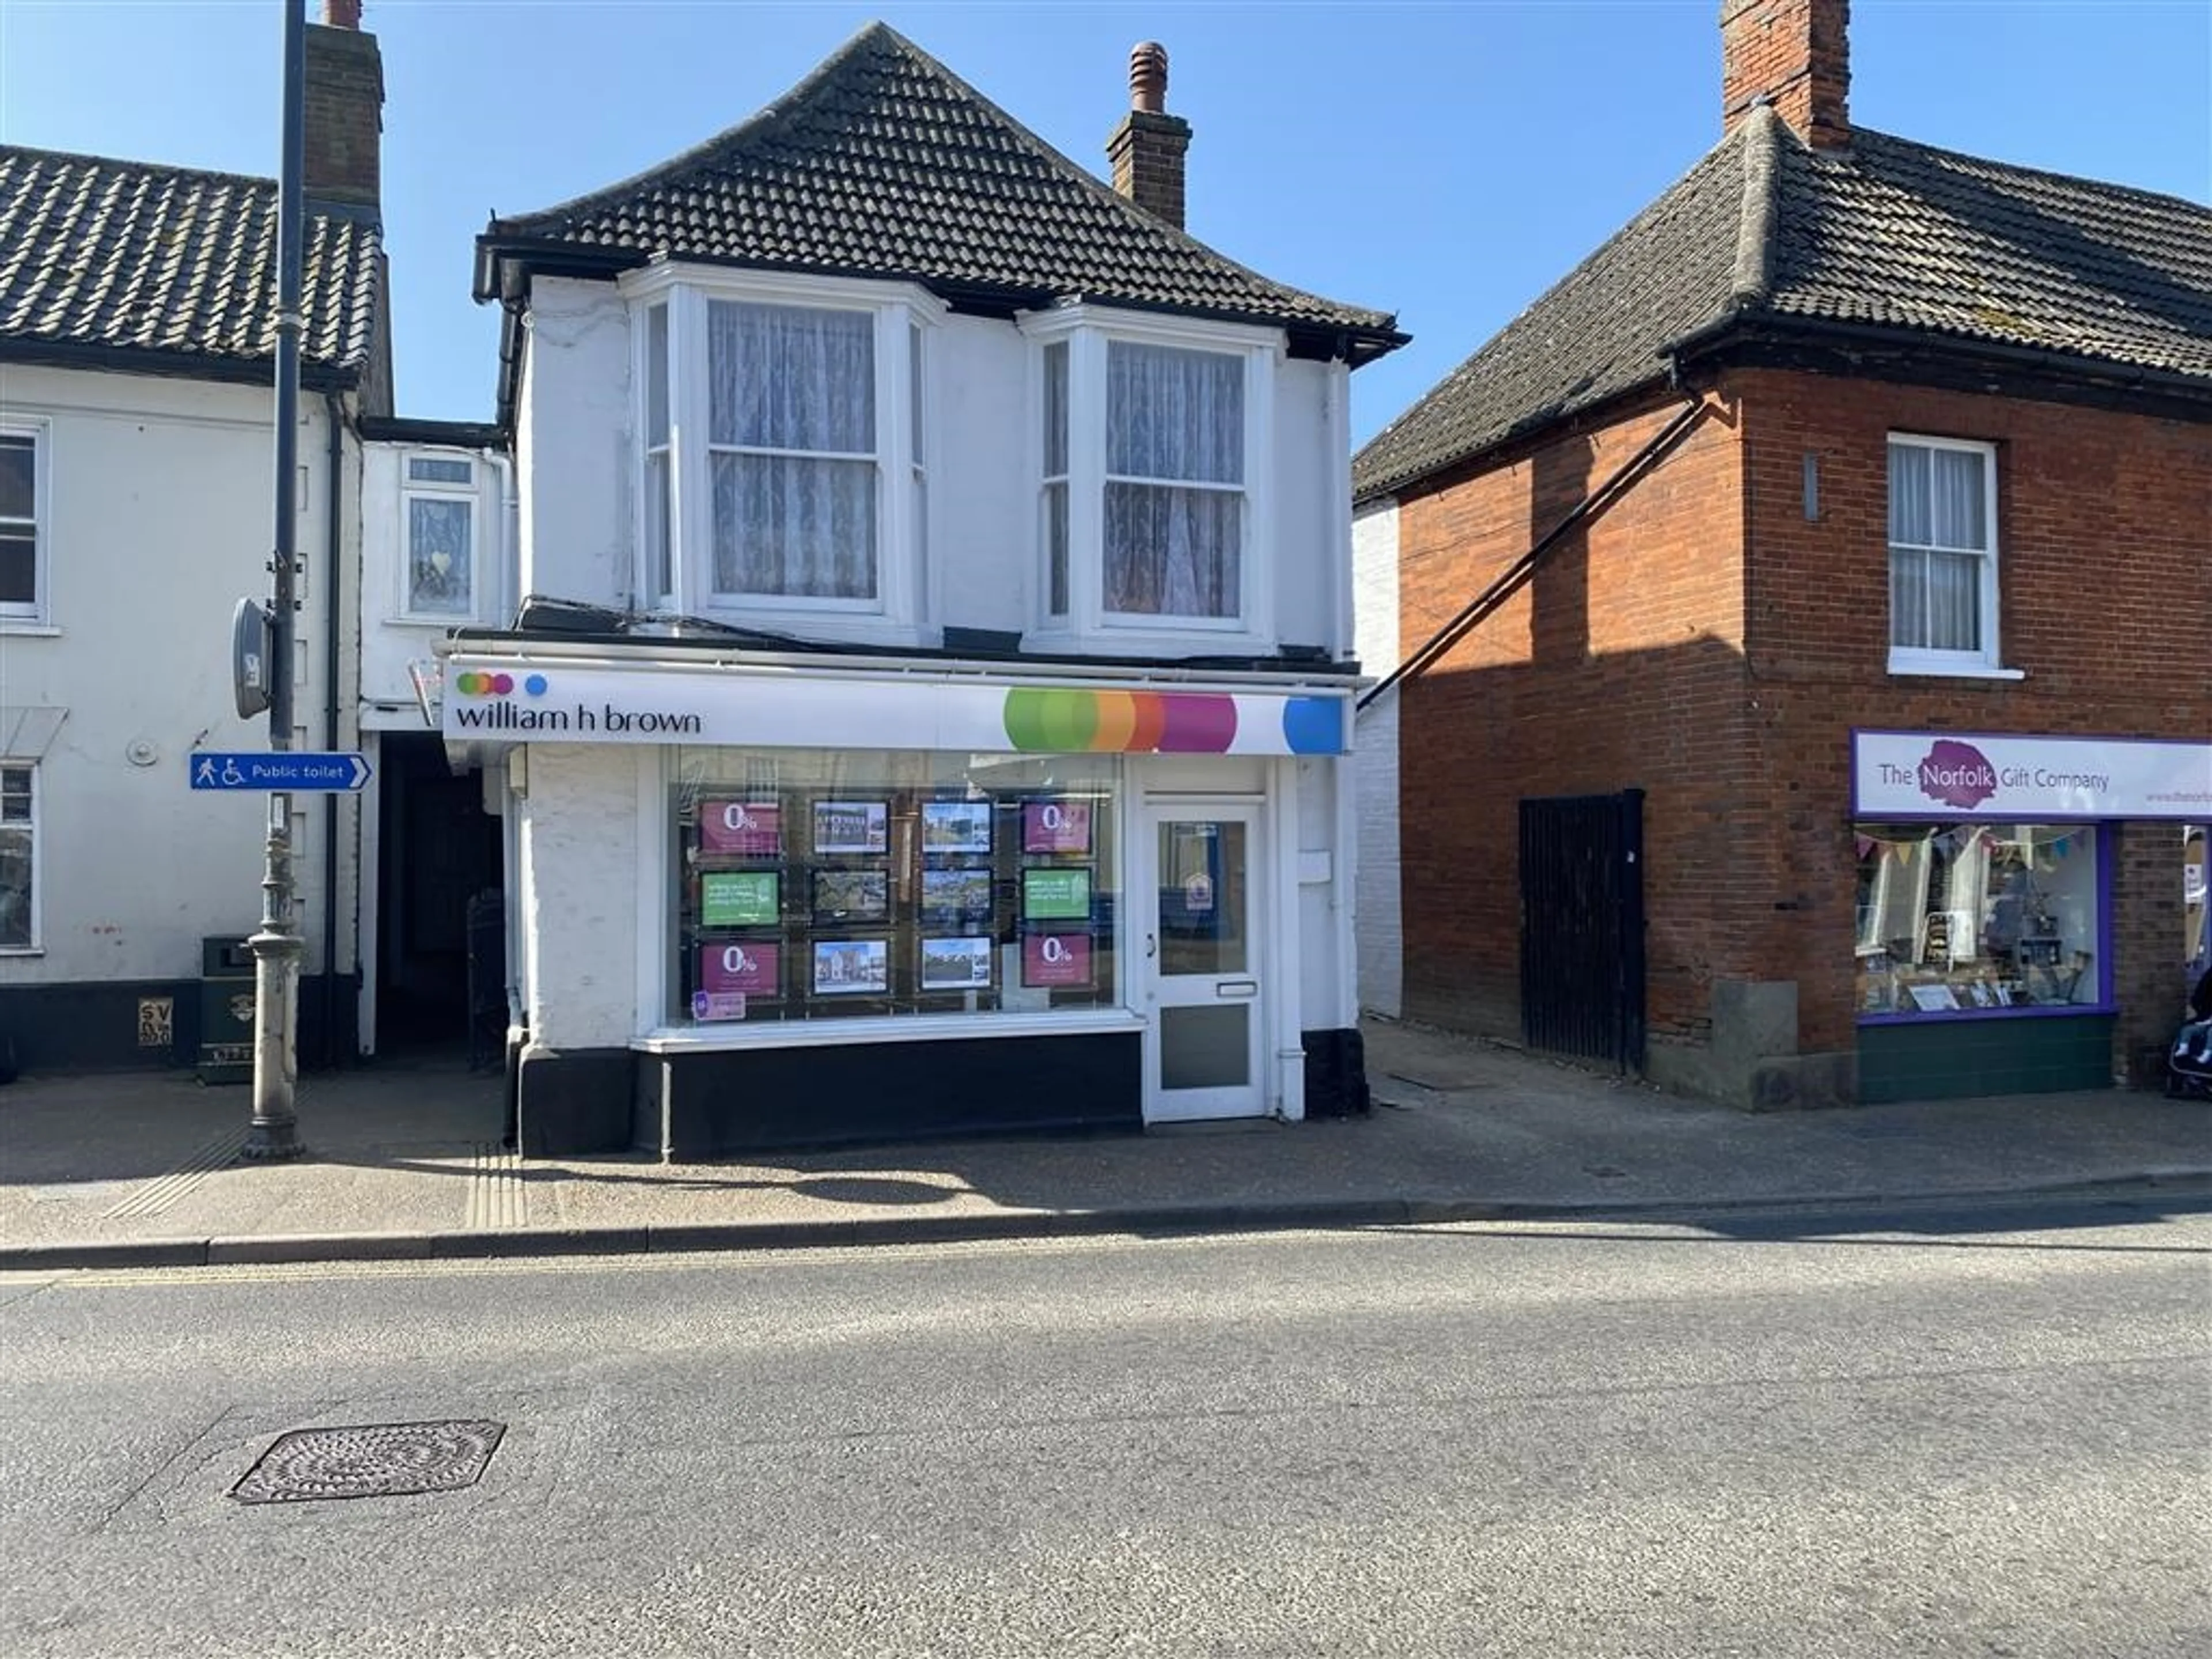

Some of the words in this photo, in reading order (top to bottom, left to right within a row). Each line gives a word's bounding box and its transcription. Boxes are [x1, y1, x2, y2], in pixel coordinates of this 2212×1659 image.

[457, 702, 567, 730] william
[578, 704, 595, 731] h
[605, 704, 701, 733] brown
[252, 764, 297, 777] Public
[304, 766, 344, 778] toilet
[1879, 764, 1913, 786] The
[1923, 765, 1994, 787] Norfolk
[2001, 768, 2029, 787] Gift
[2035, 769, 2109, 792] Company
